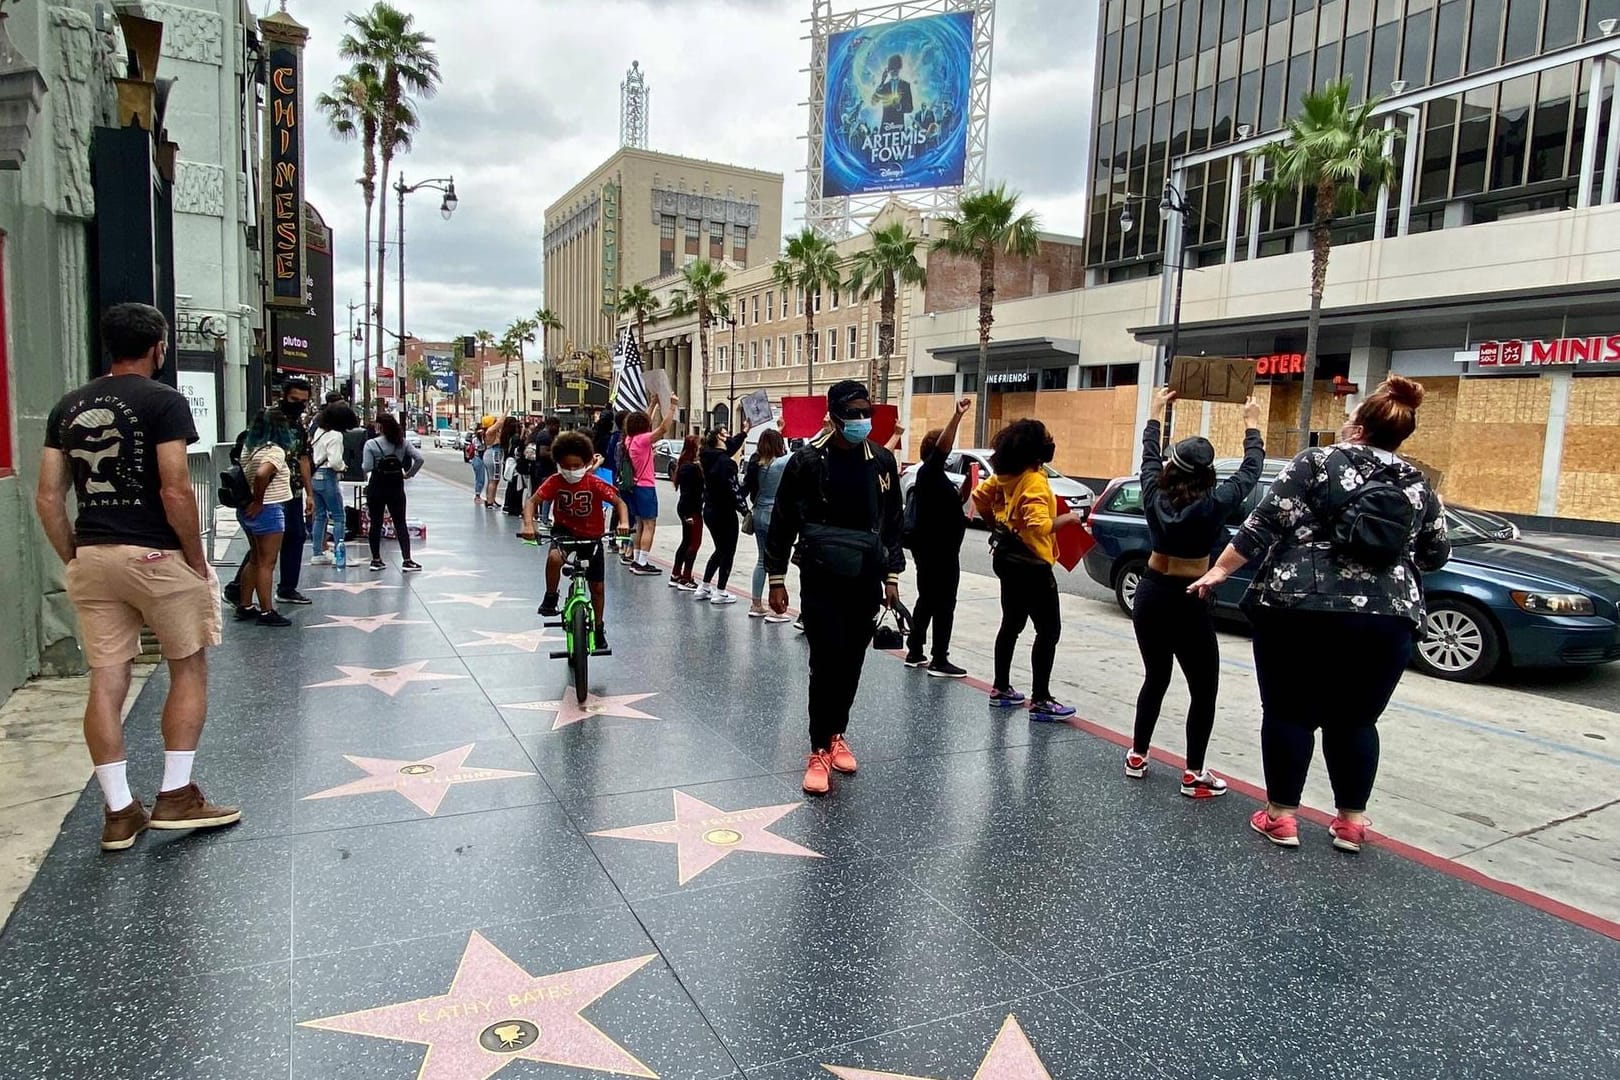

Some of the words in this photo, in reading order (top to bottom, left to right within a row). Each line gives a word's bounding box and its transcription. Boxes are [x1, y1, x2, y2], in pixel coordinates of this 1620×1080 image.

[883, 122, 904, 131] Disney
[861, 128, 927, 150] ARTEMIS
[871, 144, 915, 163] FOWL
[273, 67, 297, 279] CHINESE
[283, 336, 301, 347] pluto
[1256, 353, 1308, 374] OTER
[998, 372, 1027, 383] FRIENDS
[94, 395, 139, 425] MOTHER
[133, 430, 144, 473] EARTH
[557, 489, 593, 517] 23
[416, 998, 494, 1025] KATHY
[506, 983, 573, 1009] BATES
